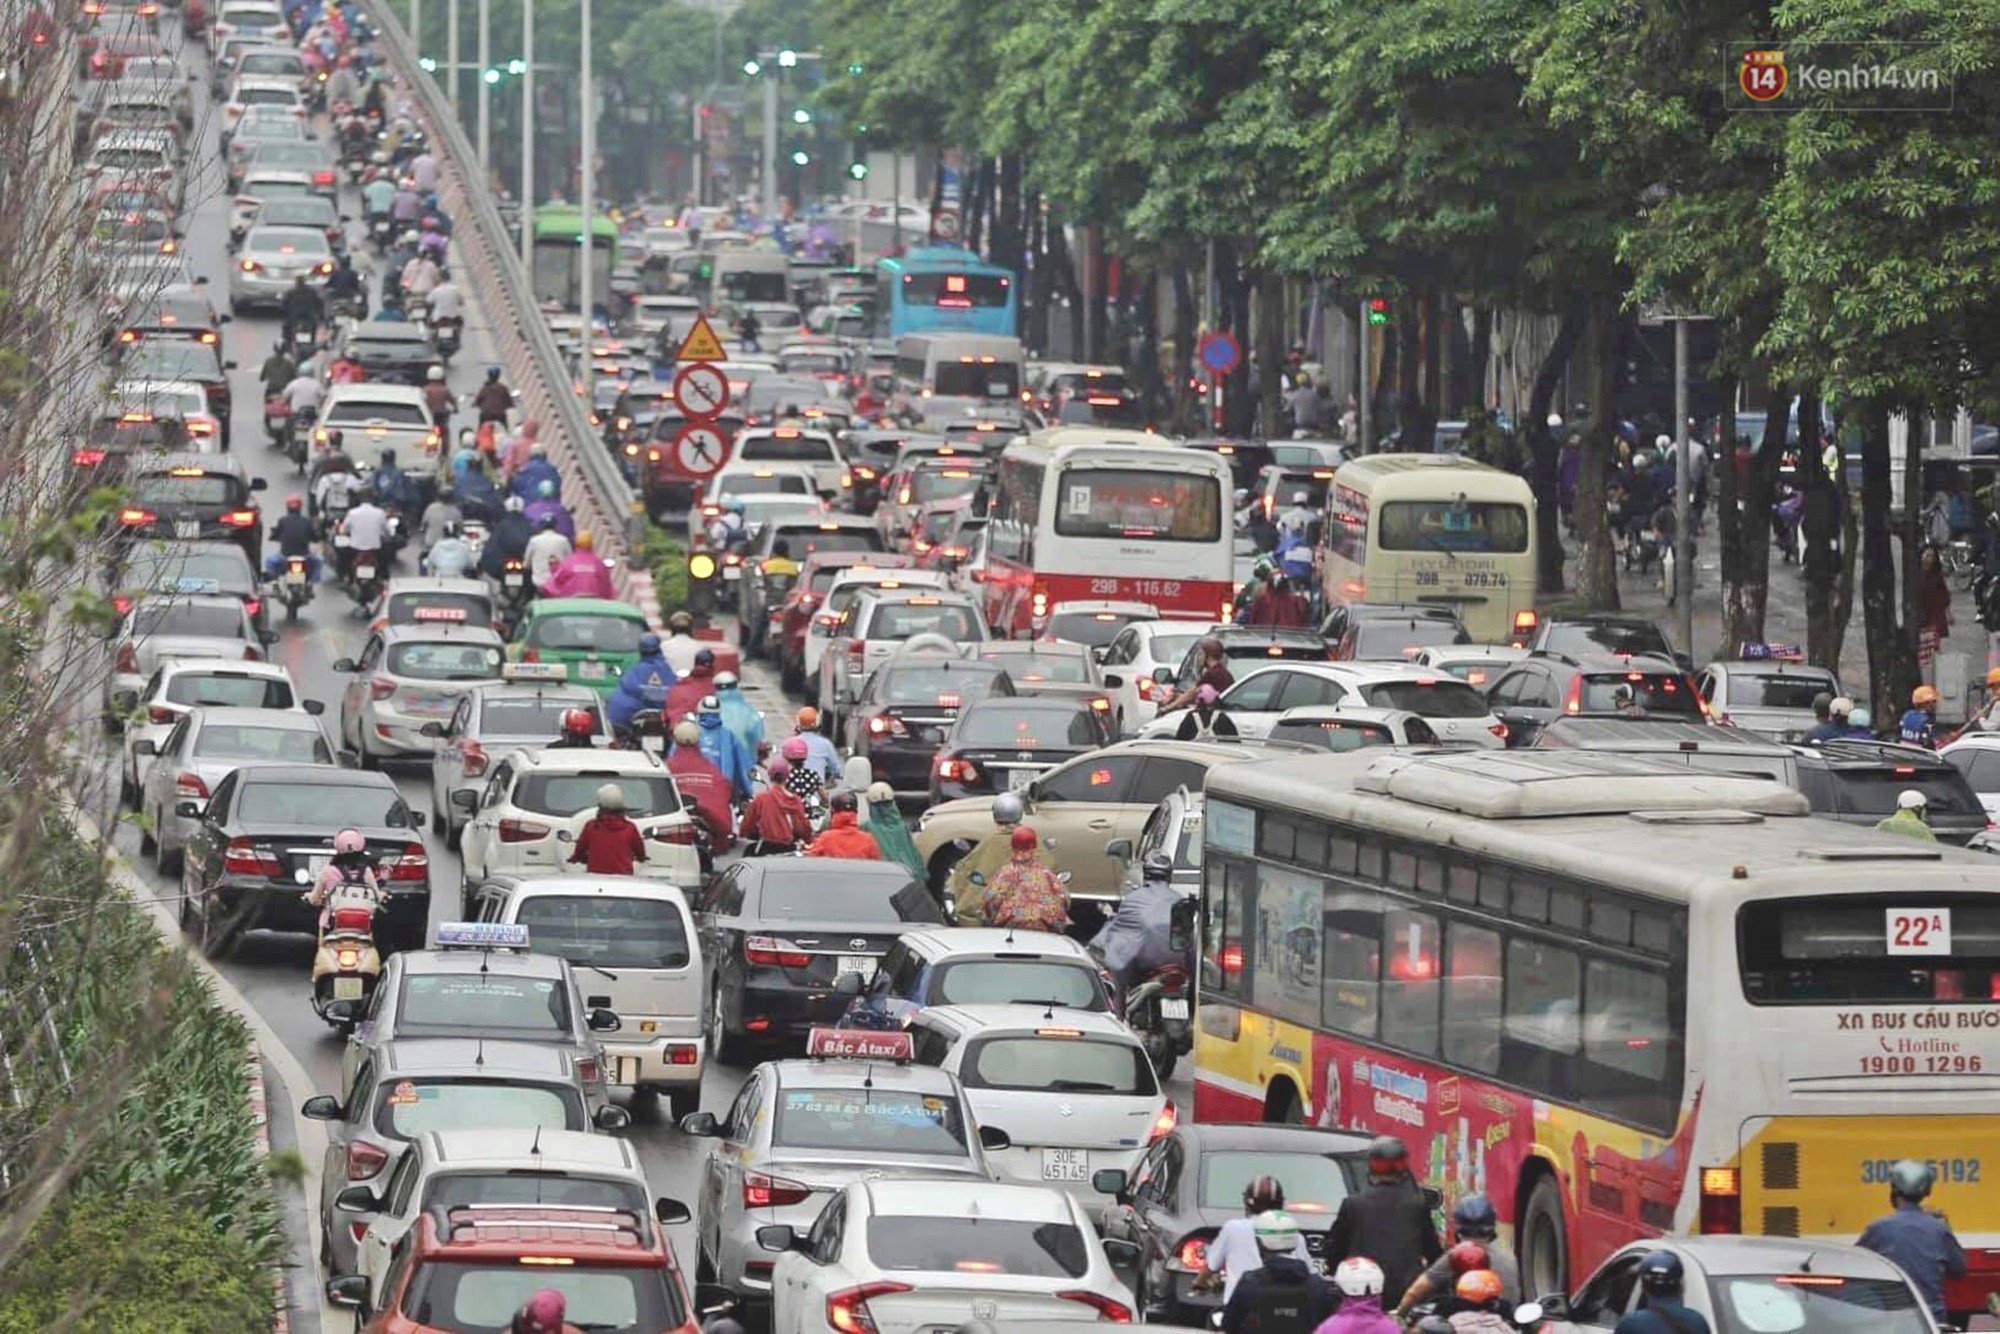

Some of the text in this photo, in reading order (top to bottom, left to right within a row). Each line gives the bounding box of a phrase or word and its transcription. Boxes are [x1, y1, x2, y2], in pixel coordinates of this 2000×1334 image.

[1871, 1012, 1907, 1030] BUS
[1898, 1038, 1961, 1053] Hotline
[1859, 1055, 1982, 1073] 1900 1296
[1053, 1149, 1077, 1164] 30E
